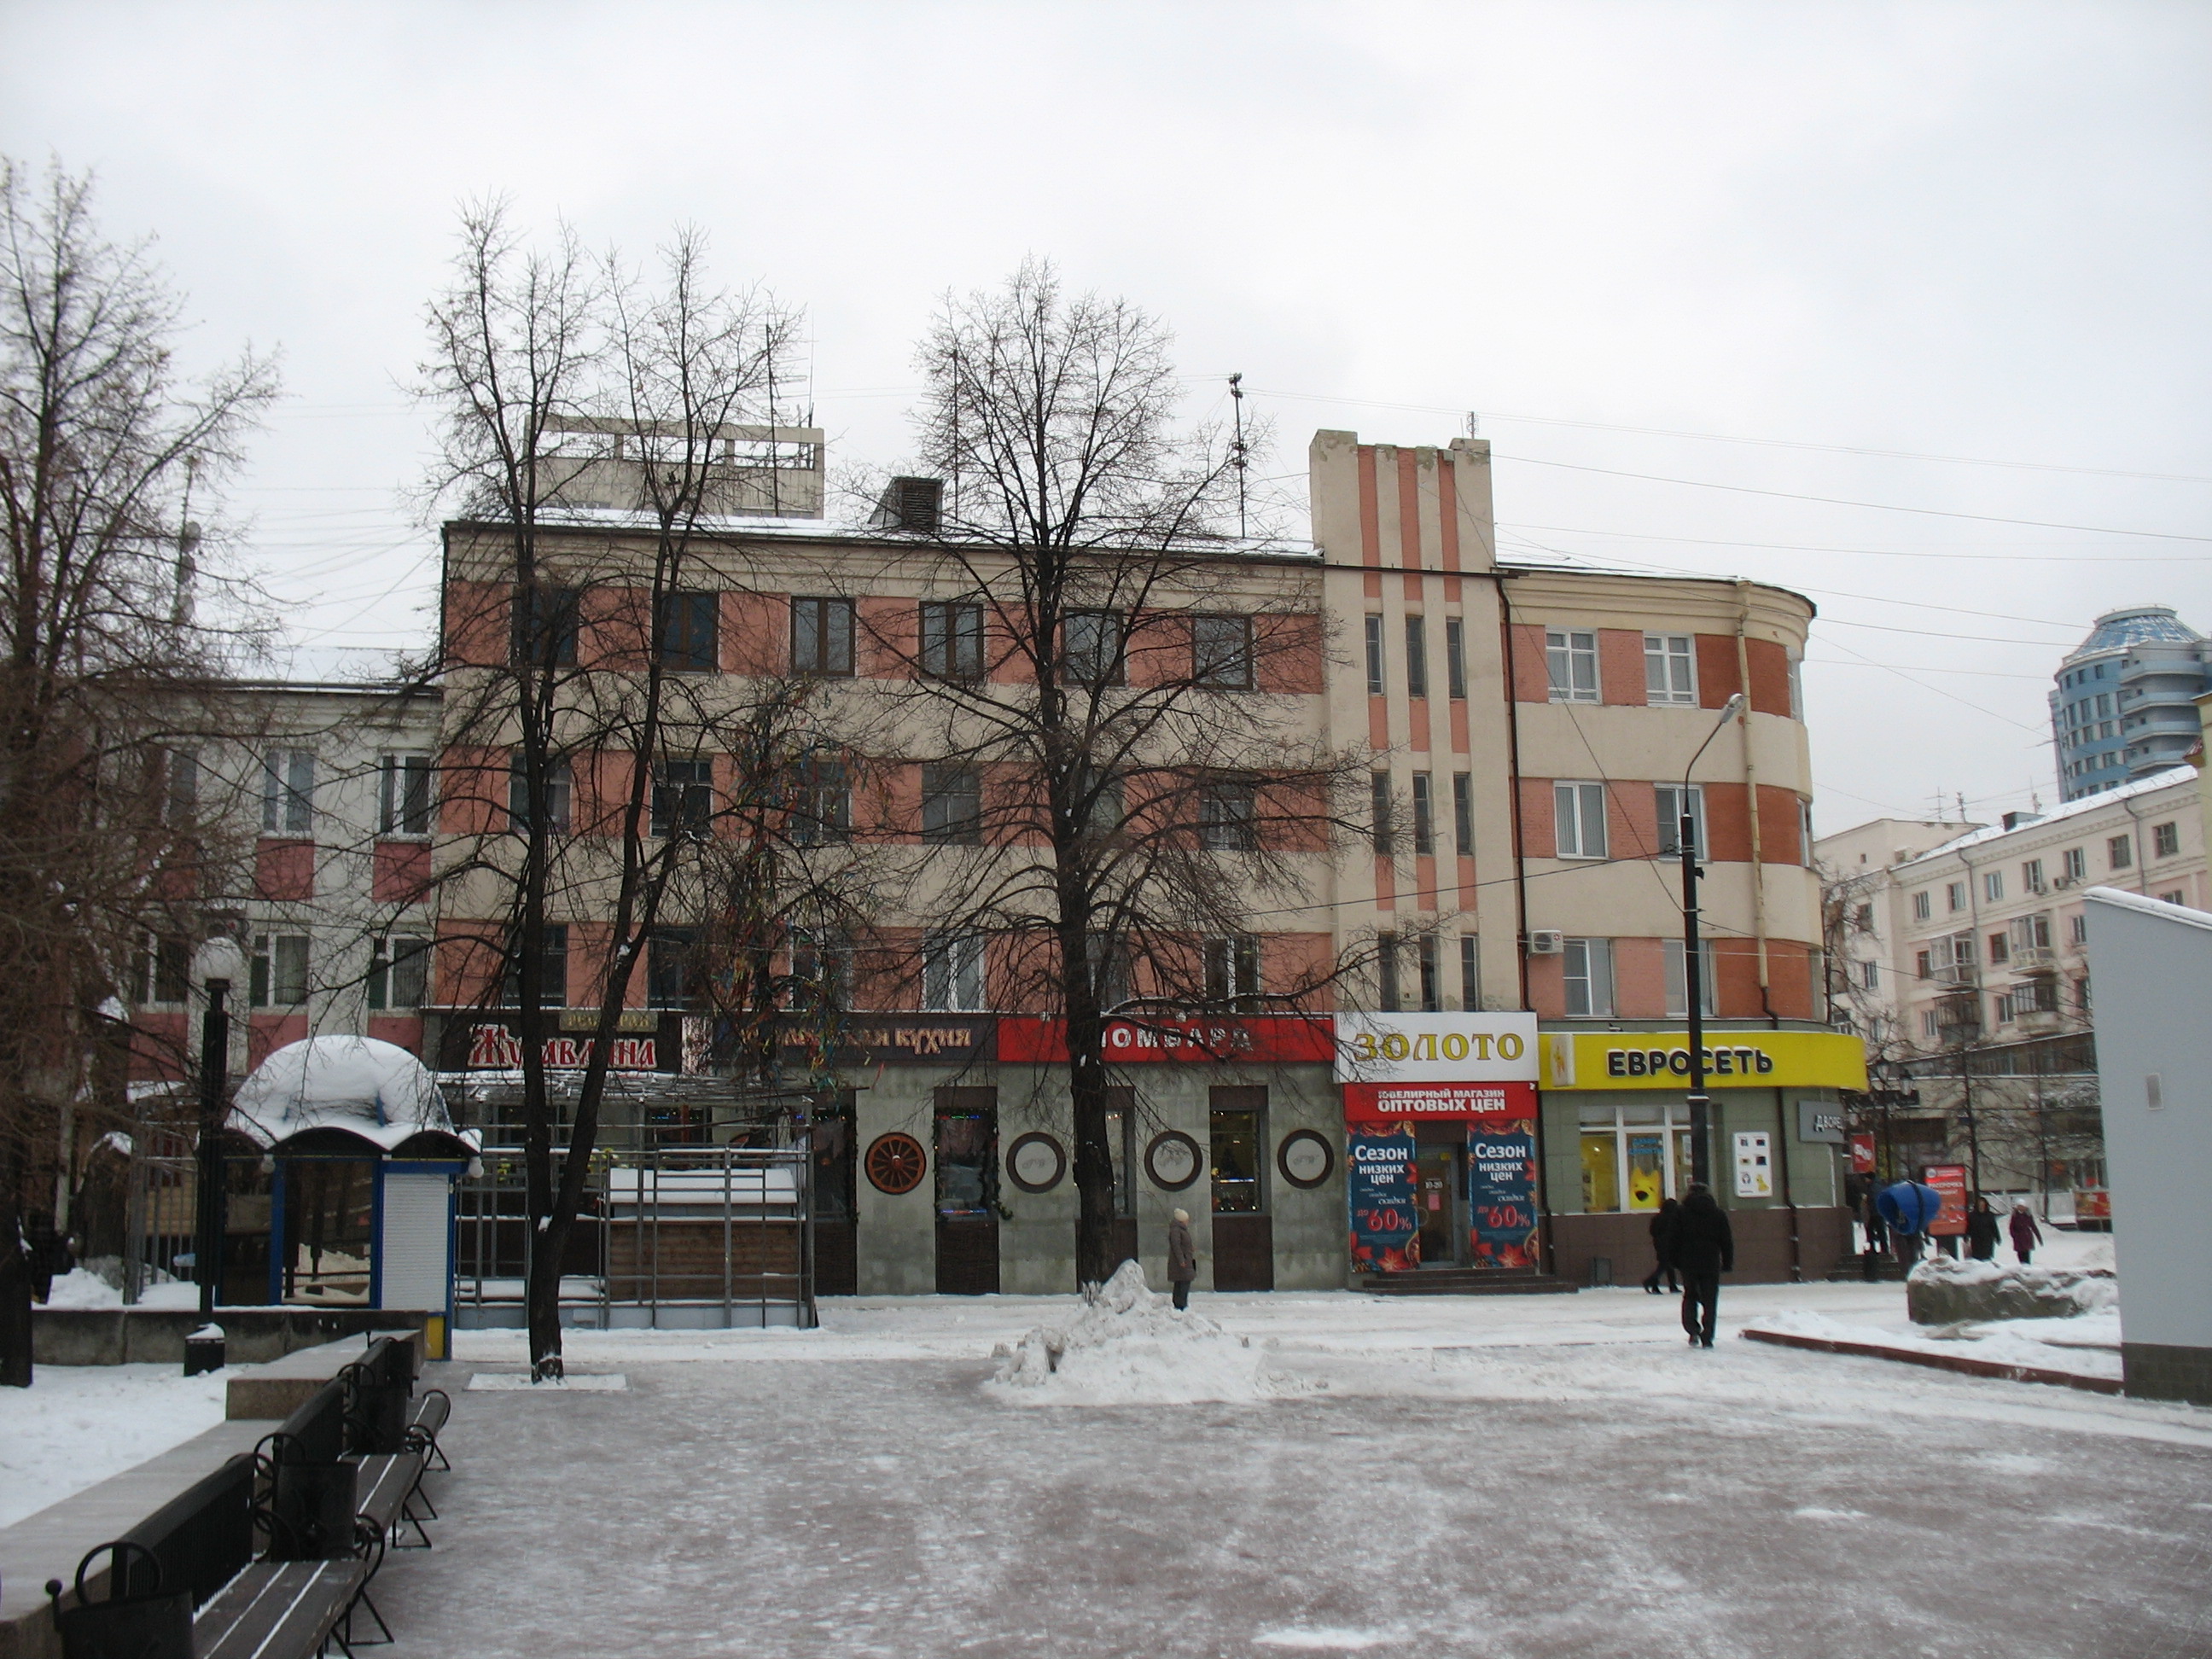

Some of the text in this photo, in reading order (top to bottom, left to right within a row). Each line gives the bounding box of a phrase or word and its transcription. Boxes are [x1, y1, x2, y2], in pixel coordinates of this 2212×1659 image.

[568, 1014, 649, 1027] РЕСРАН
[1353, 1033, 1525, 1062] ЗОЛОТО
[1608, 1048, 1773, 1076] ЕВРОСЕТЬ
[1378, 1088, 1505, 1099] ЮВЕЛИРНЫЙ МАГАЗИН
[1377, 1097, 1506, 1114] ОПТОВЫХ ЦЕН
[1354, 1144, 1408, 1161] Сезон
[1475, 1143, 1526, 1159] Сезон
[1359, 1164, 1405, 1175] низких
[1479, 1161, 1523, 1172] низких
[1371, 1174, 1394, 1185] цен
[1490, 1171, 1513, 1182] цен
